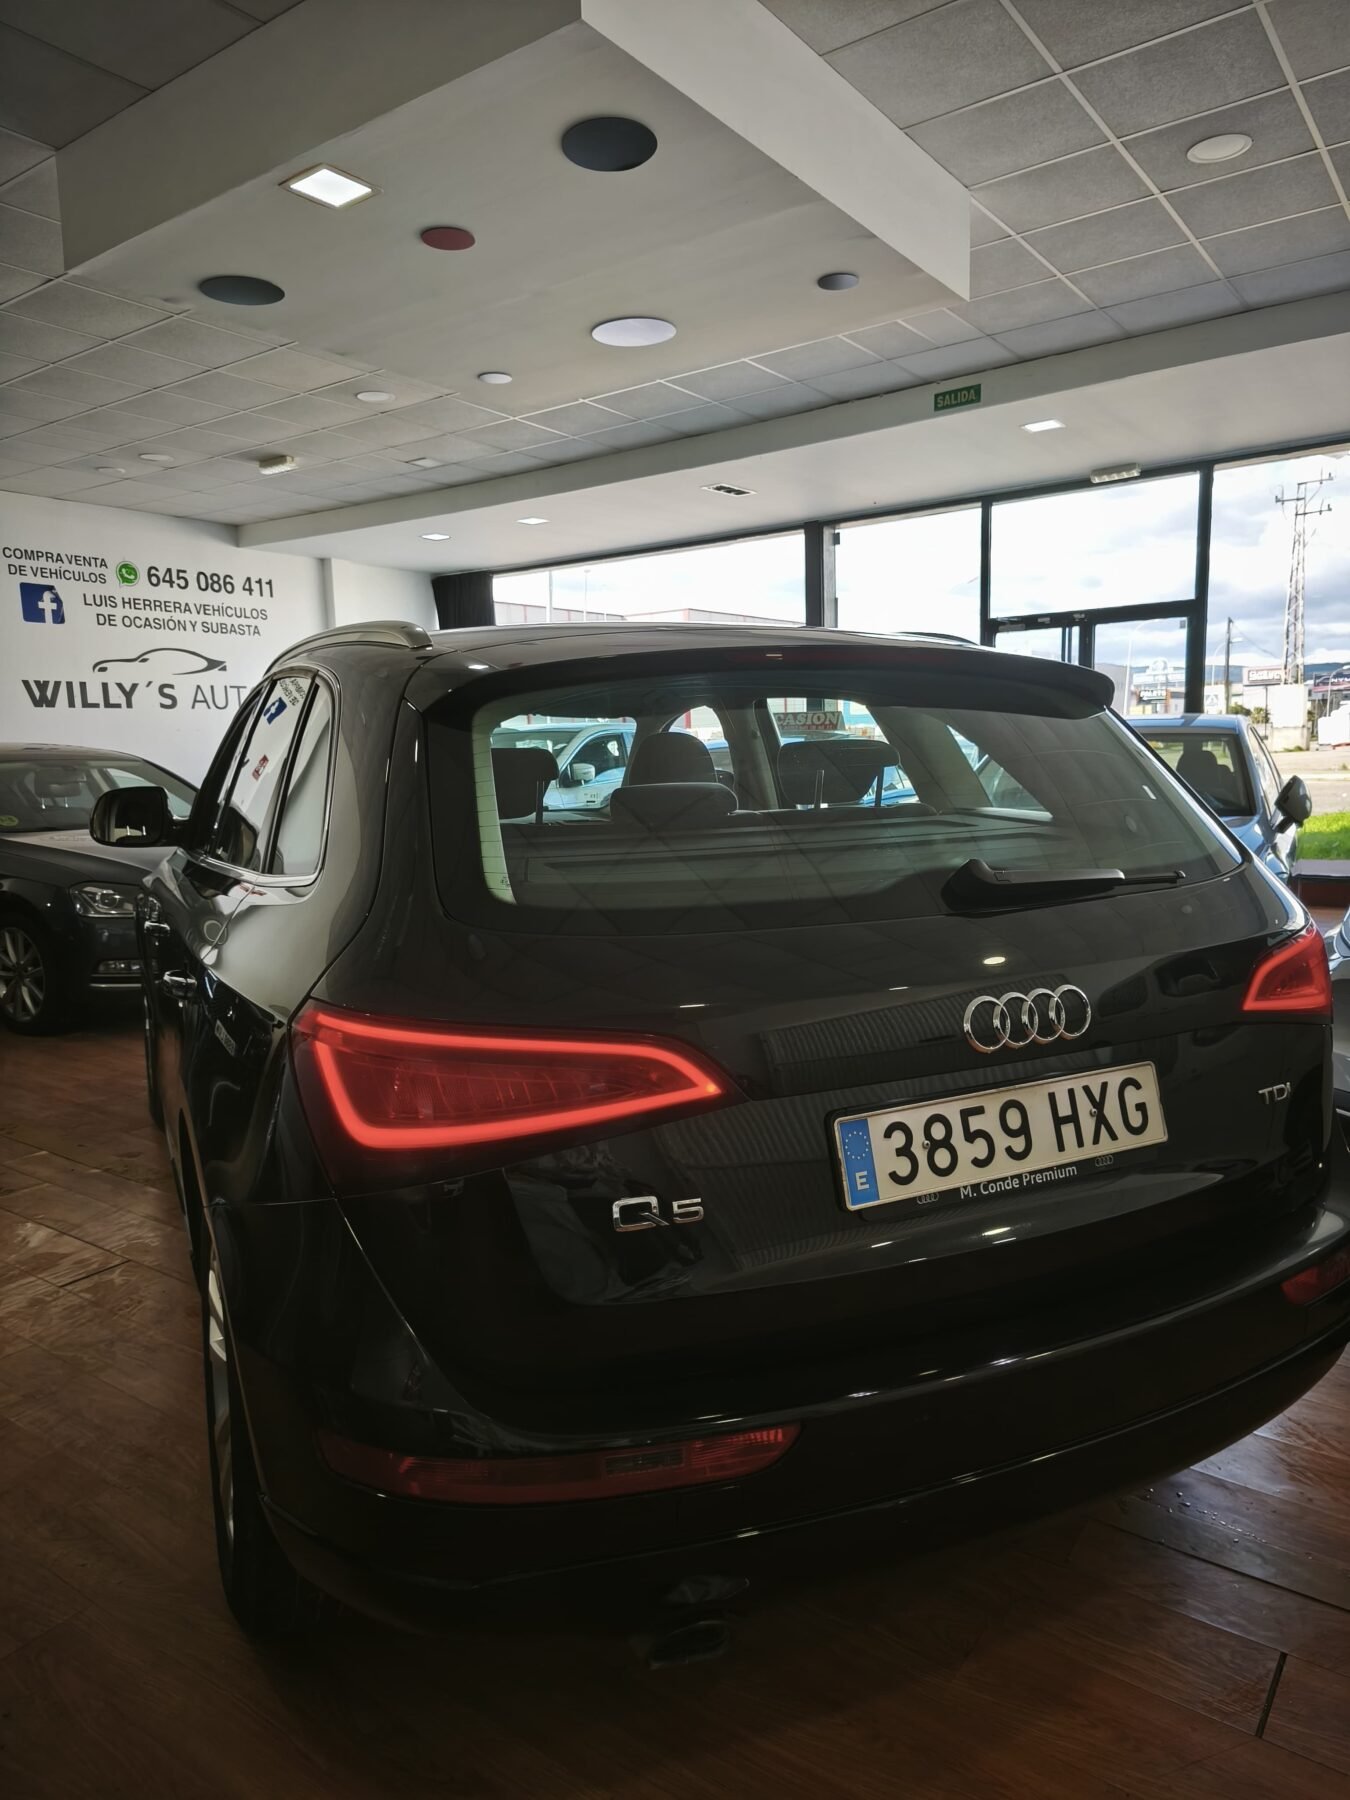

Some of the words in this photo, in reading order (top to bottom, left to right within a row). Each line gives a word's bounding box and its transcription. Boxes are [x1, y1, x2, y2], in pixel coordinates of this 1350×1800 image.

[937, 389, 976, 408] SALIDA
[2, 546, 65, 564] COMPRA
[65, 553, 109, 569] VENTA
[8, 564, 28, 576] DE
[30, 566, 107, 584] VEHÍCULOS
[147, 566, 189, 590] 645
[196, 571, 235, 595] 086
[242, 576, 274, 598] 411
[83, 593, 118, 608] LUIS
[122, 597, 192, 614] HERRERA
[193, 603, 268, 620] VEHÍCULOS
[96, 613, 118, 627] DE
[121, 615, 187, 632] OCASIÓN
[188, 620, 198, 633] Y
[201, 621, 261, 636] SUBASTA
[191, 684, 248, 710] AUT
[775, 712, 838, 725] CASION
[1258, 1082, 1291, 1104] TDI
[883, 1098, 1033, 1186] 3859
[1048, 1077, 1149, 1152] HXG
[855, 1171, 870, 1191] E
[960, 1186, 977, 1199] M.
[980, 1177, 1020, 1195] Conde
[1022, 1166, 1078, 1186] Premium
[612, 1195, 704, 1232] Q5
